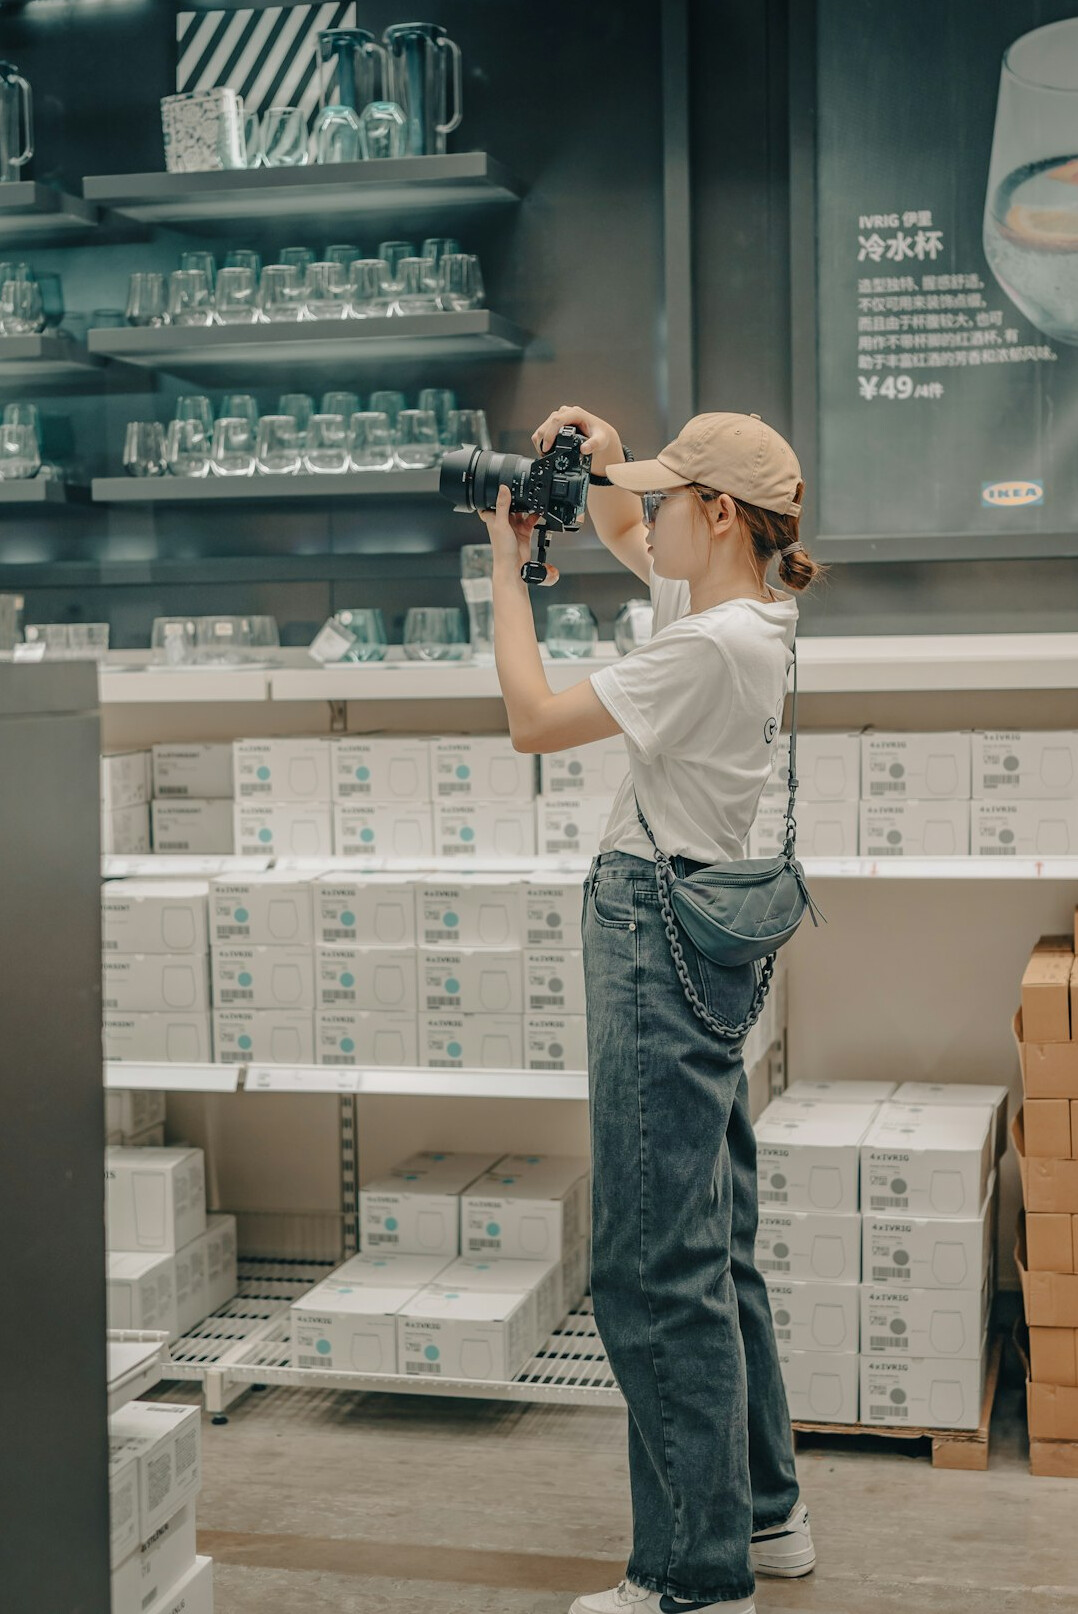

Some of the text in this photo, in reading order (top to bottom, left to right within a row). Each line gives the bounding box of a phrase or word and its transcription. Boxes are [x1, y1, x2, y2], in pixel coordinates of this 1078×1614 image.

[859, 213, 899, 229] IVRIG
[857, 231, 944, 262] 冷水杯
[988, 487, 1038, 499] IKEA
[757, 1148, 790, 1158] xIVRIG
[759, 1217, 792, 1227] xIVRIG
